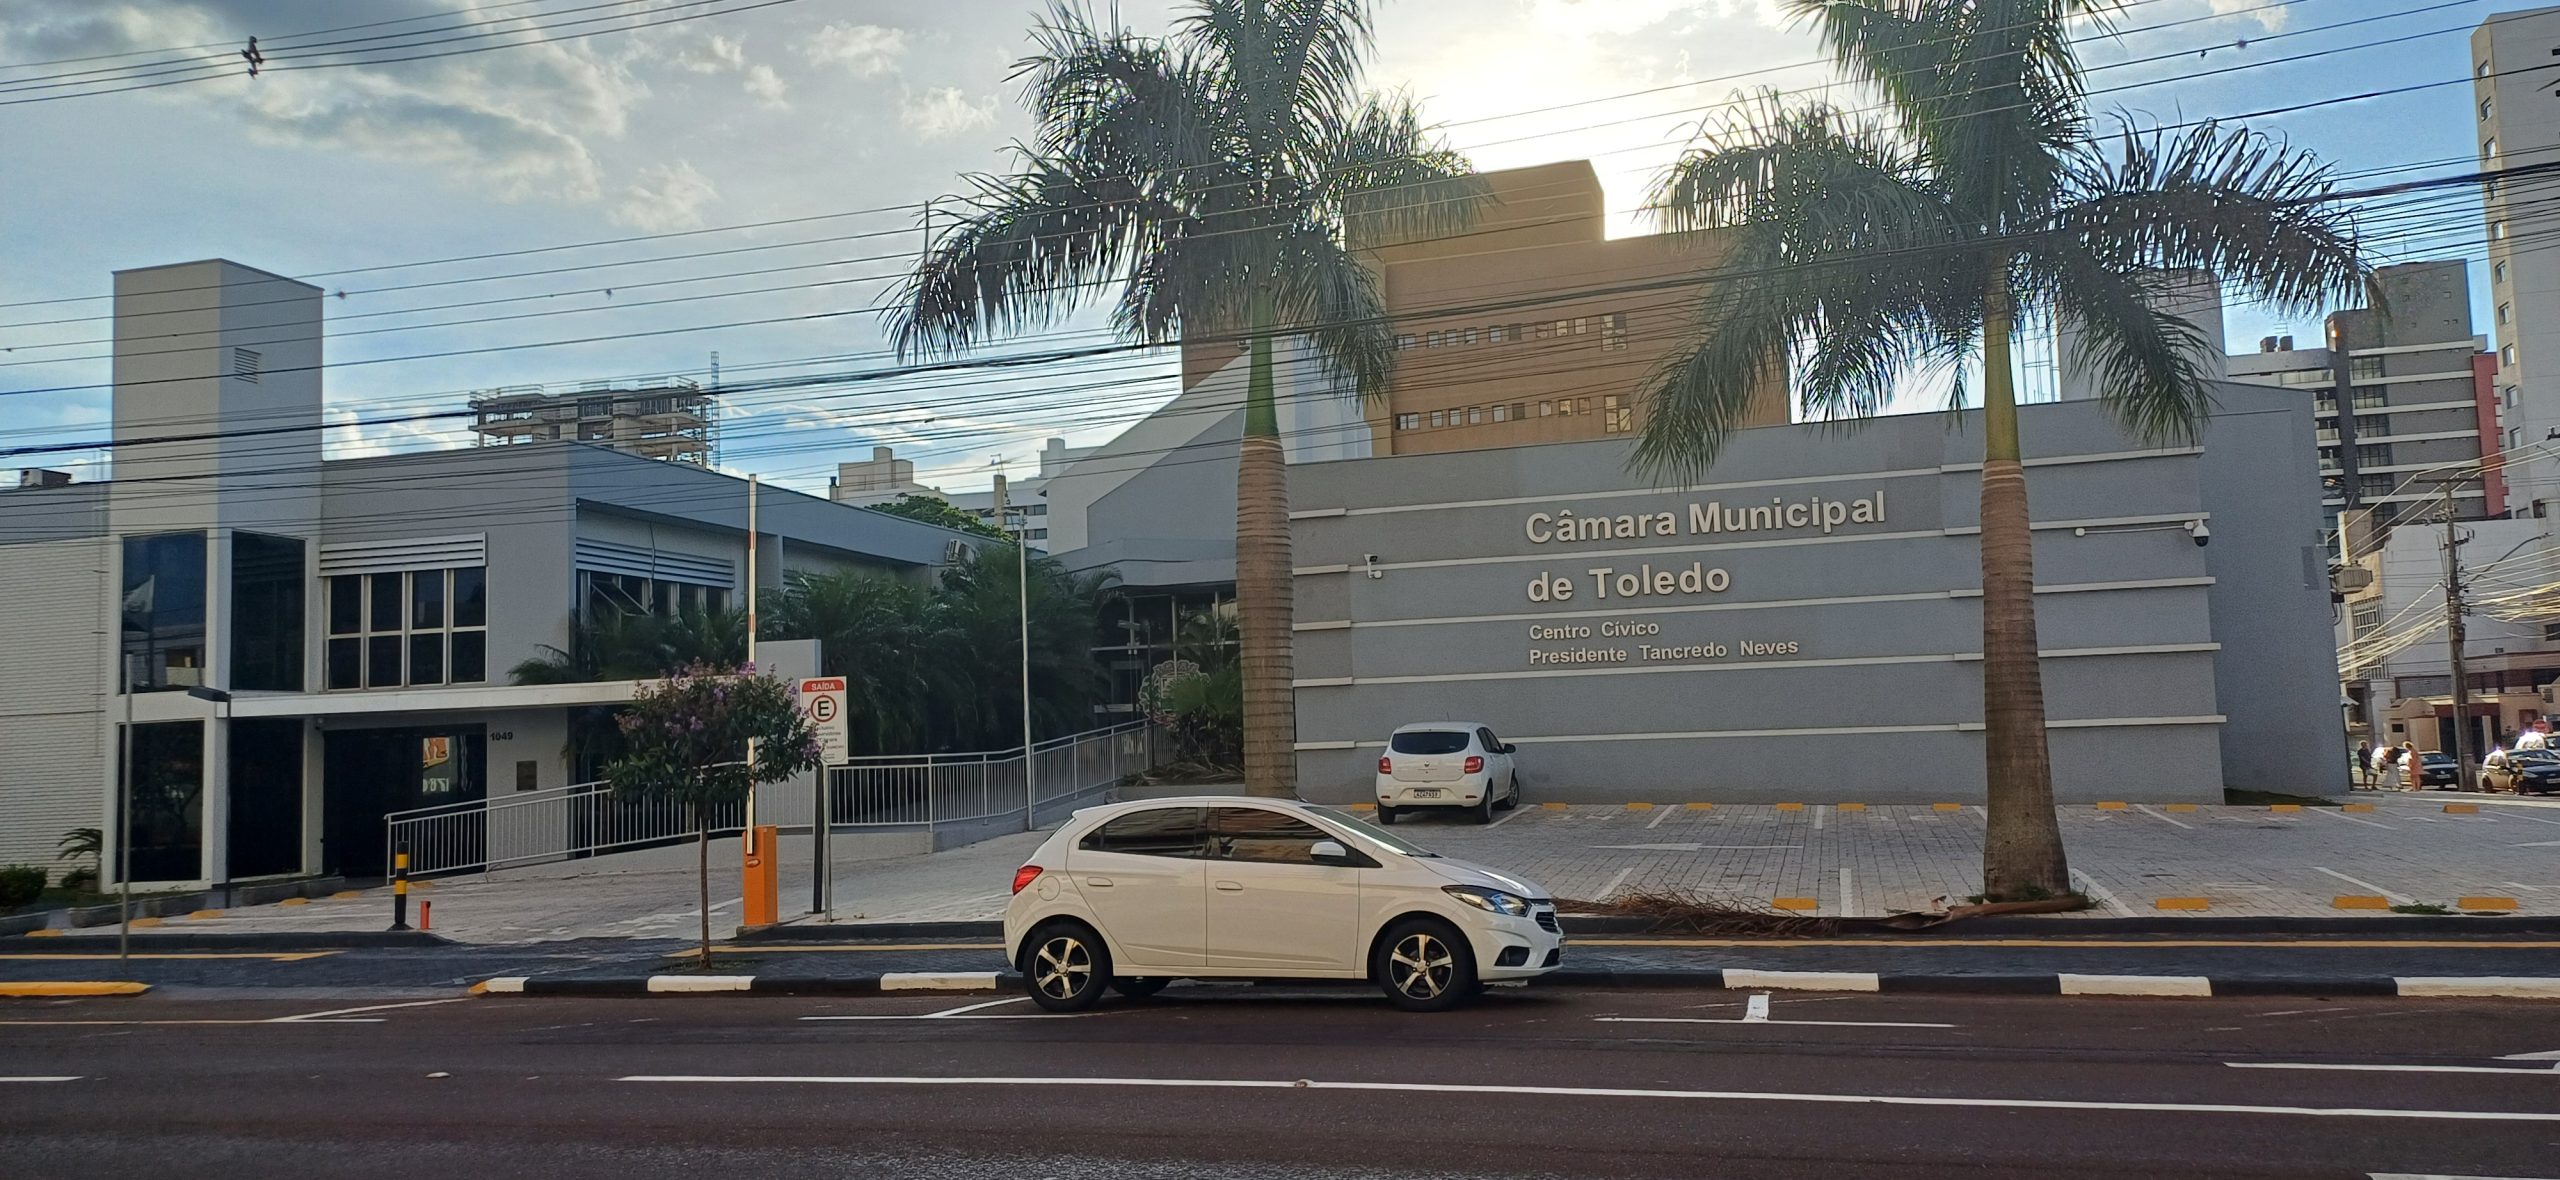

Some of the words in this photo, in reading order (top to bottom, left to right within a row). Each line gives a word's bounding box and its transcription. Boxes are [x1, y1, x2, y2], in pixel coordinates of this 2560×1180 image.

[1525, 509, 1677, 543] Câmara
[1688, 490, 1886, 533] Municipal
[1526, 571, 1574, 603] de
[1588, 561, 1731, 599] Toledo
[1528, 623, 1591, 641] Centro
[1601, 620, 1660, 638] Cívico
[1529, 646, 1627, 665] Presidente
[1639, 642, 1728, 661] Tancredo
[1739, 639, 1799, 657] Neves
[811, 682, 836, 691] SAÍDA
[817, 700, 830, 716] E
[490, 732, 513, 741] 1049
